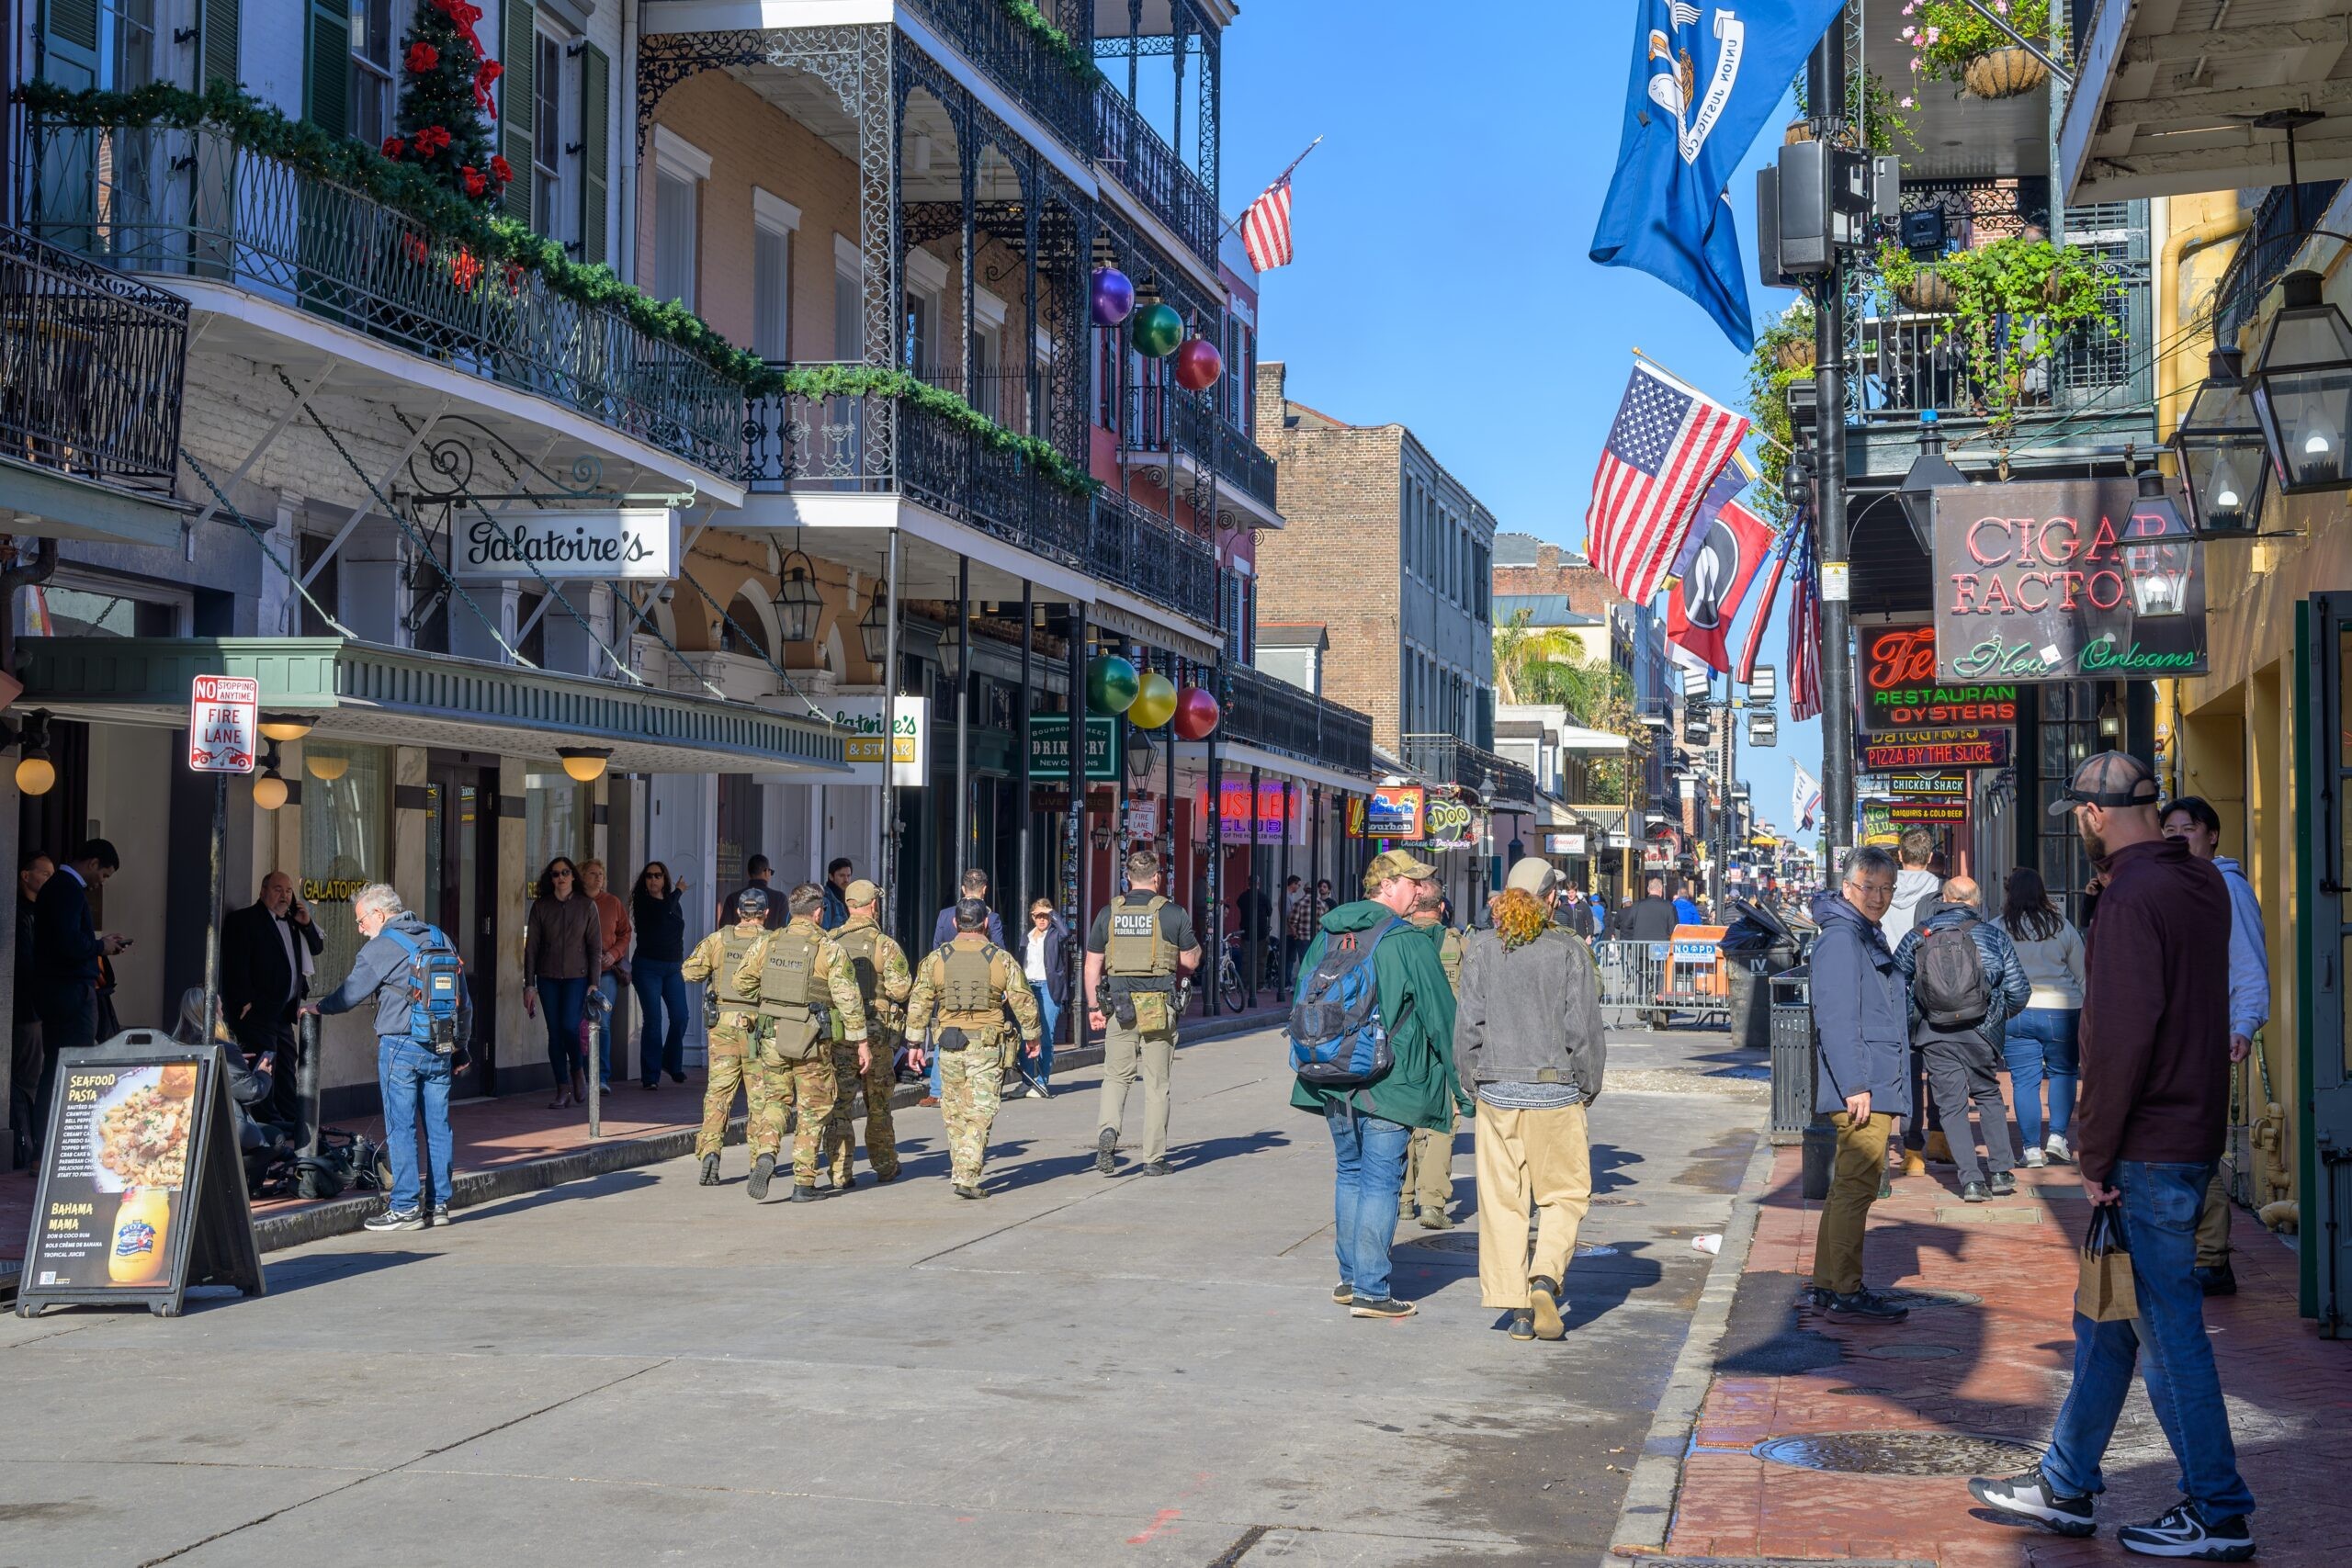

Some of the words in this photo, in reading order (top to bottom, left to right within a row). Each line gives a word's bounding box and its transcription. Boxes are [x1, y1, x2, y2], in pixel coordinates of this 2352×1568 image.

[468, 522, 654, 564] Galatoire's
[1966, 513, 2175, 566] CIGAR
[1951, 570, 2194, 614] FACTO
[2080, 637, 2197, 671] Orleans
[196, 681, 217, 698] NO
[218, 682, 254, 691] STOPPING
[208, 708, 241, 724] FIRE
[1891, 704, 2016, 723] OYSTERS
[204, 728, 242, 743] LANE
[849, 743, 859, 755] &
[864, 744, 910, 756] STAK
[1032, 740, 1106, 755] DRINRY
[1869, 749, 1904, 766] PIZZA
[1907, 748, 1925, 764] BY
[1928, 745, 1953, 762] THE
[1956, 743, 1992, 761] SLICE
[1894, 780, 1930, 790] CHICKEN
[1934, 781, 1963, 791] SHACK
[1131, 801, 1139, 810] NO
[1135, 813, 1148, 821] FIRE
[1133, 821, 1149, 829] LANE
[1114, 915, 1153, 928] POLICE
[1750, 958, 1767, 972] IV
[70, 1074, 116, 1088] SEAFOOD
[68, 1089, 97, 1102] PASTA
[51, 1202, 93, 1215] BAHAMA
[49, 1219, 79, 1231] MAMA
